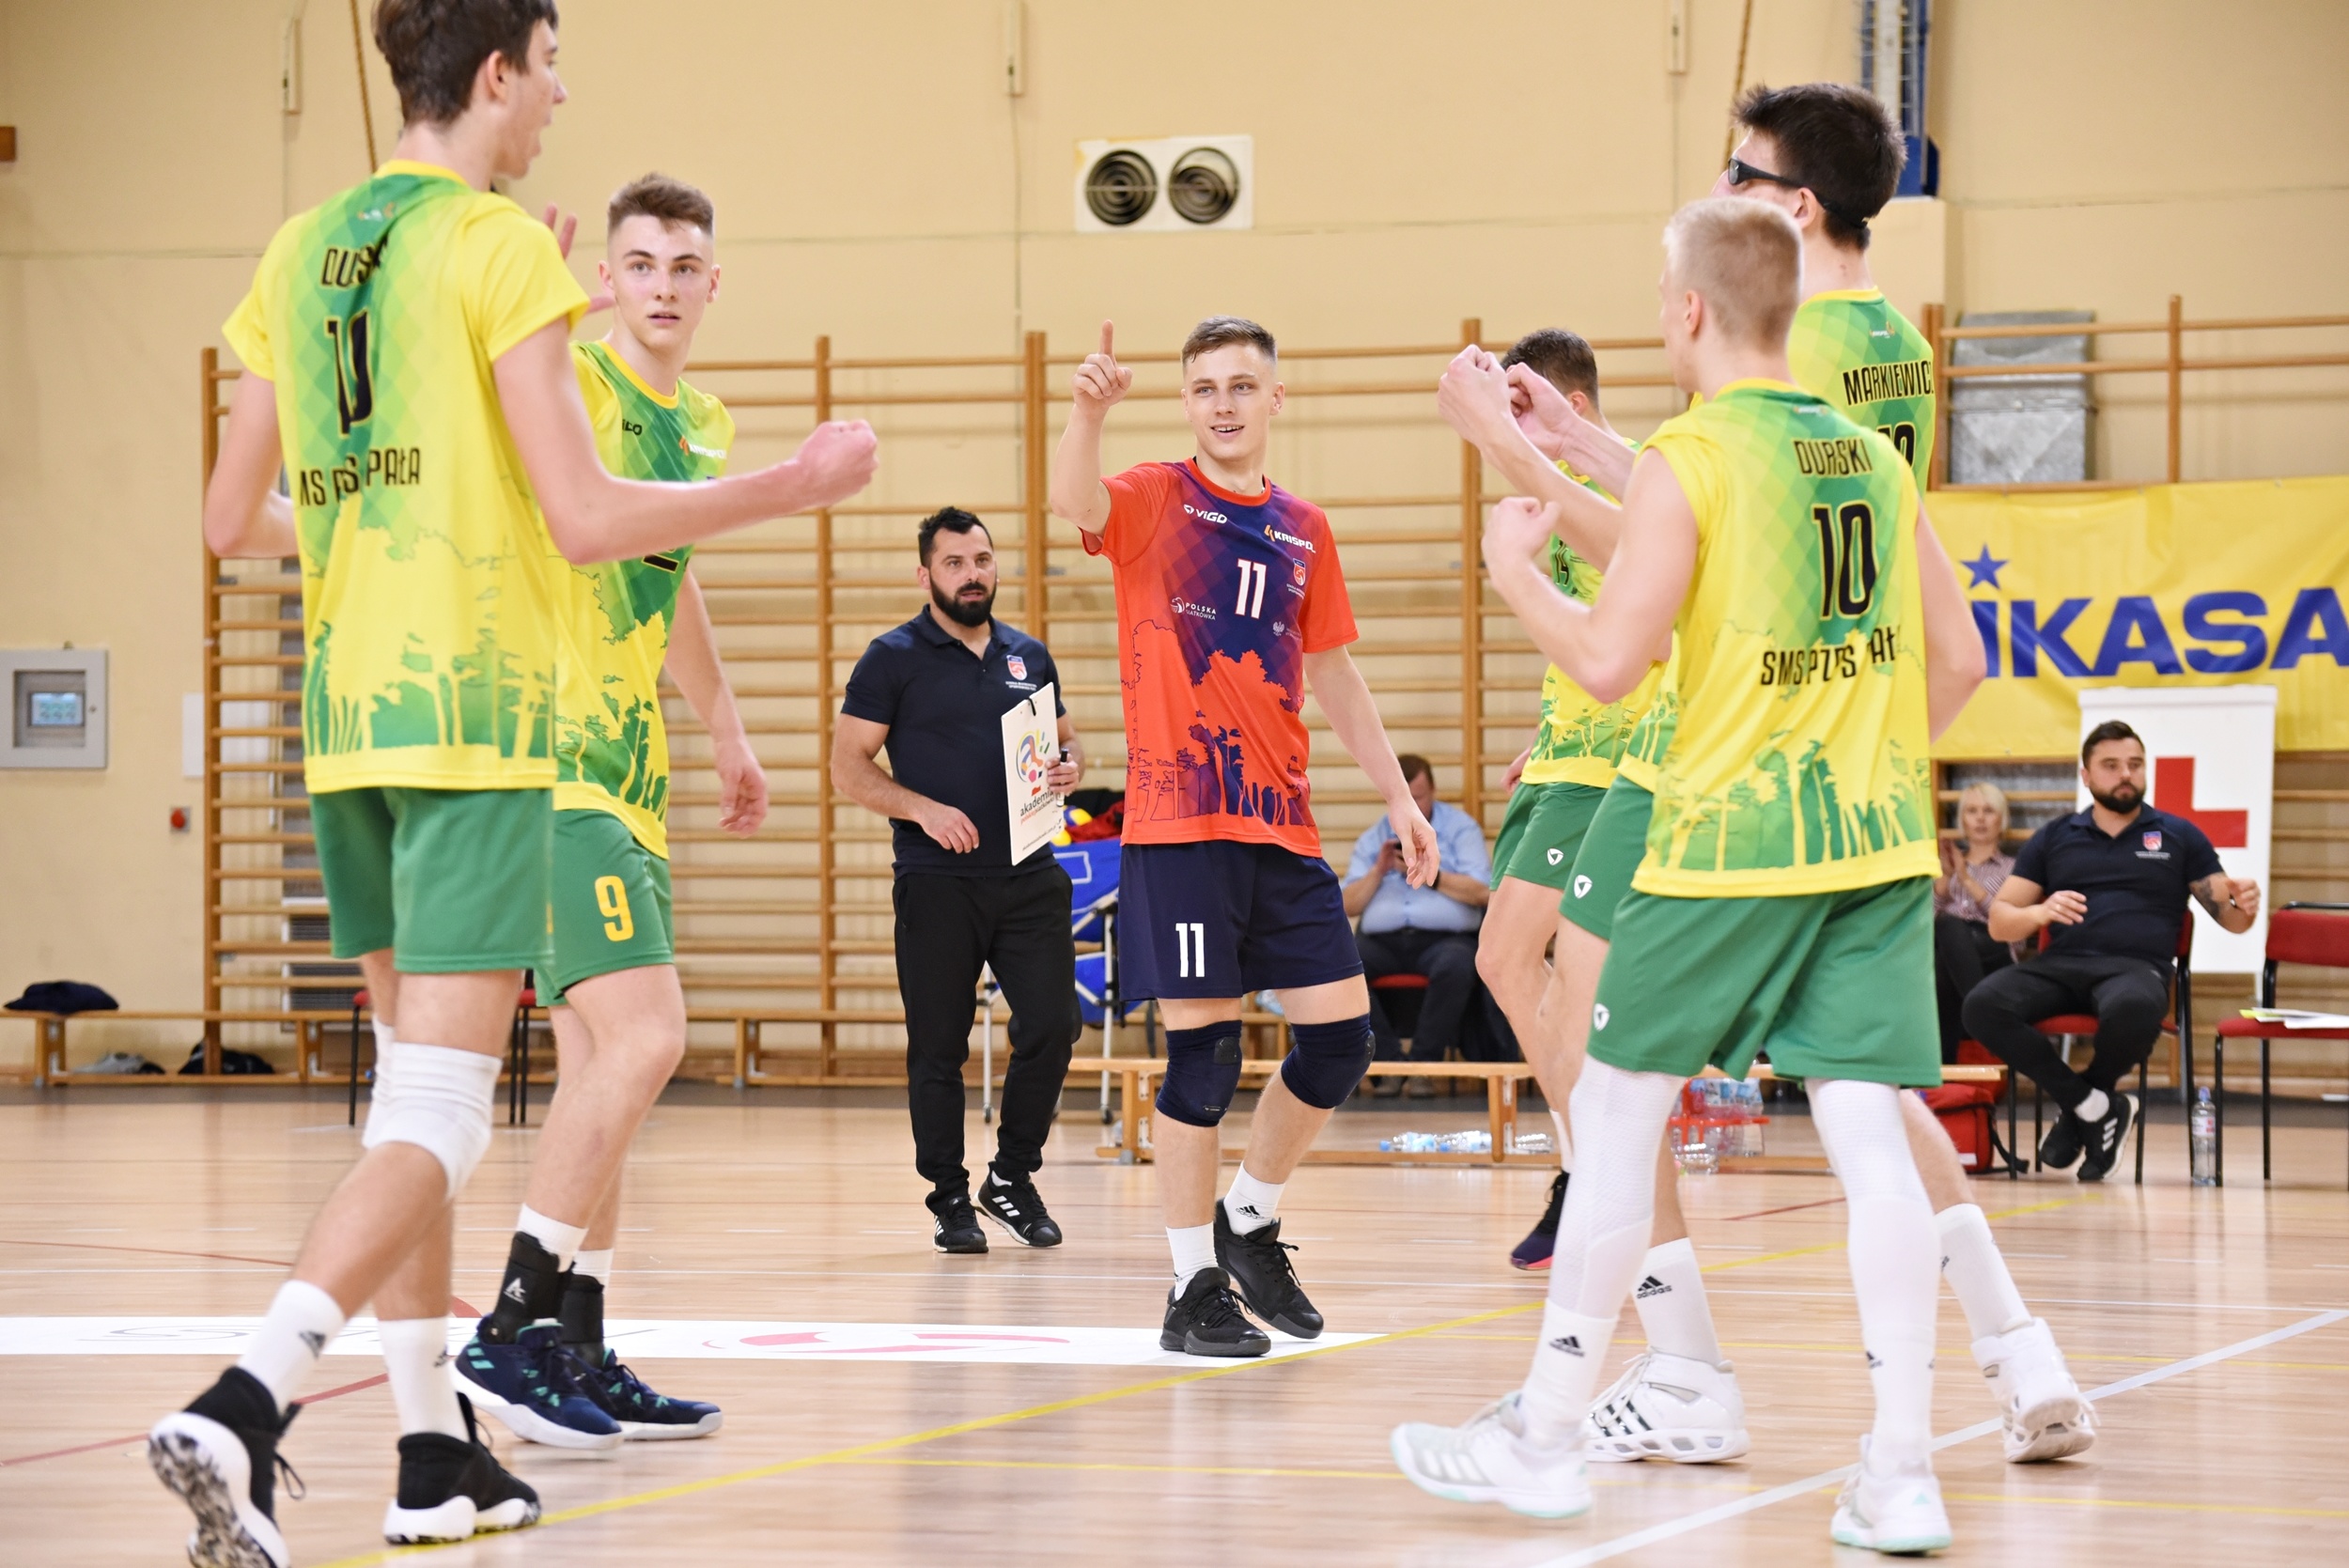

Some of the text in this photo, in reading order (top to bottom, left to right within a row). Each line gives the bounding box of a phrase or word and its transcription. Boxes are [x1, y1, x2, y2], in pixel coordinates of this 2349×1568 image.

[1843, 359, 1935, 407] MARKIEWIC
[1793, 438, 1873, 475] DURSKI
[1812, 503, 1877, 618] 10
[1185, 602, 1217, 614] POLSKA
[1235, 557, 1267, 620] 11
[594, 875, 634, 942] 9
[1175, 923, 1206, 978] 11
